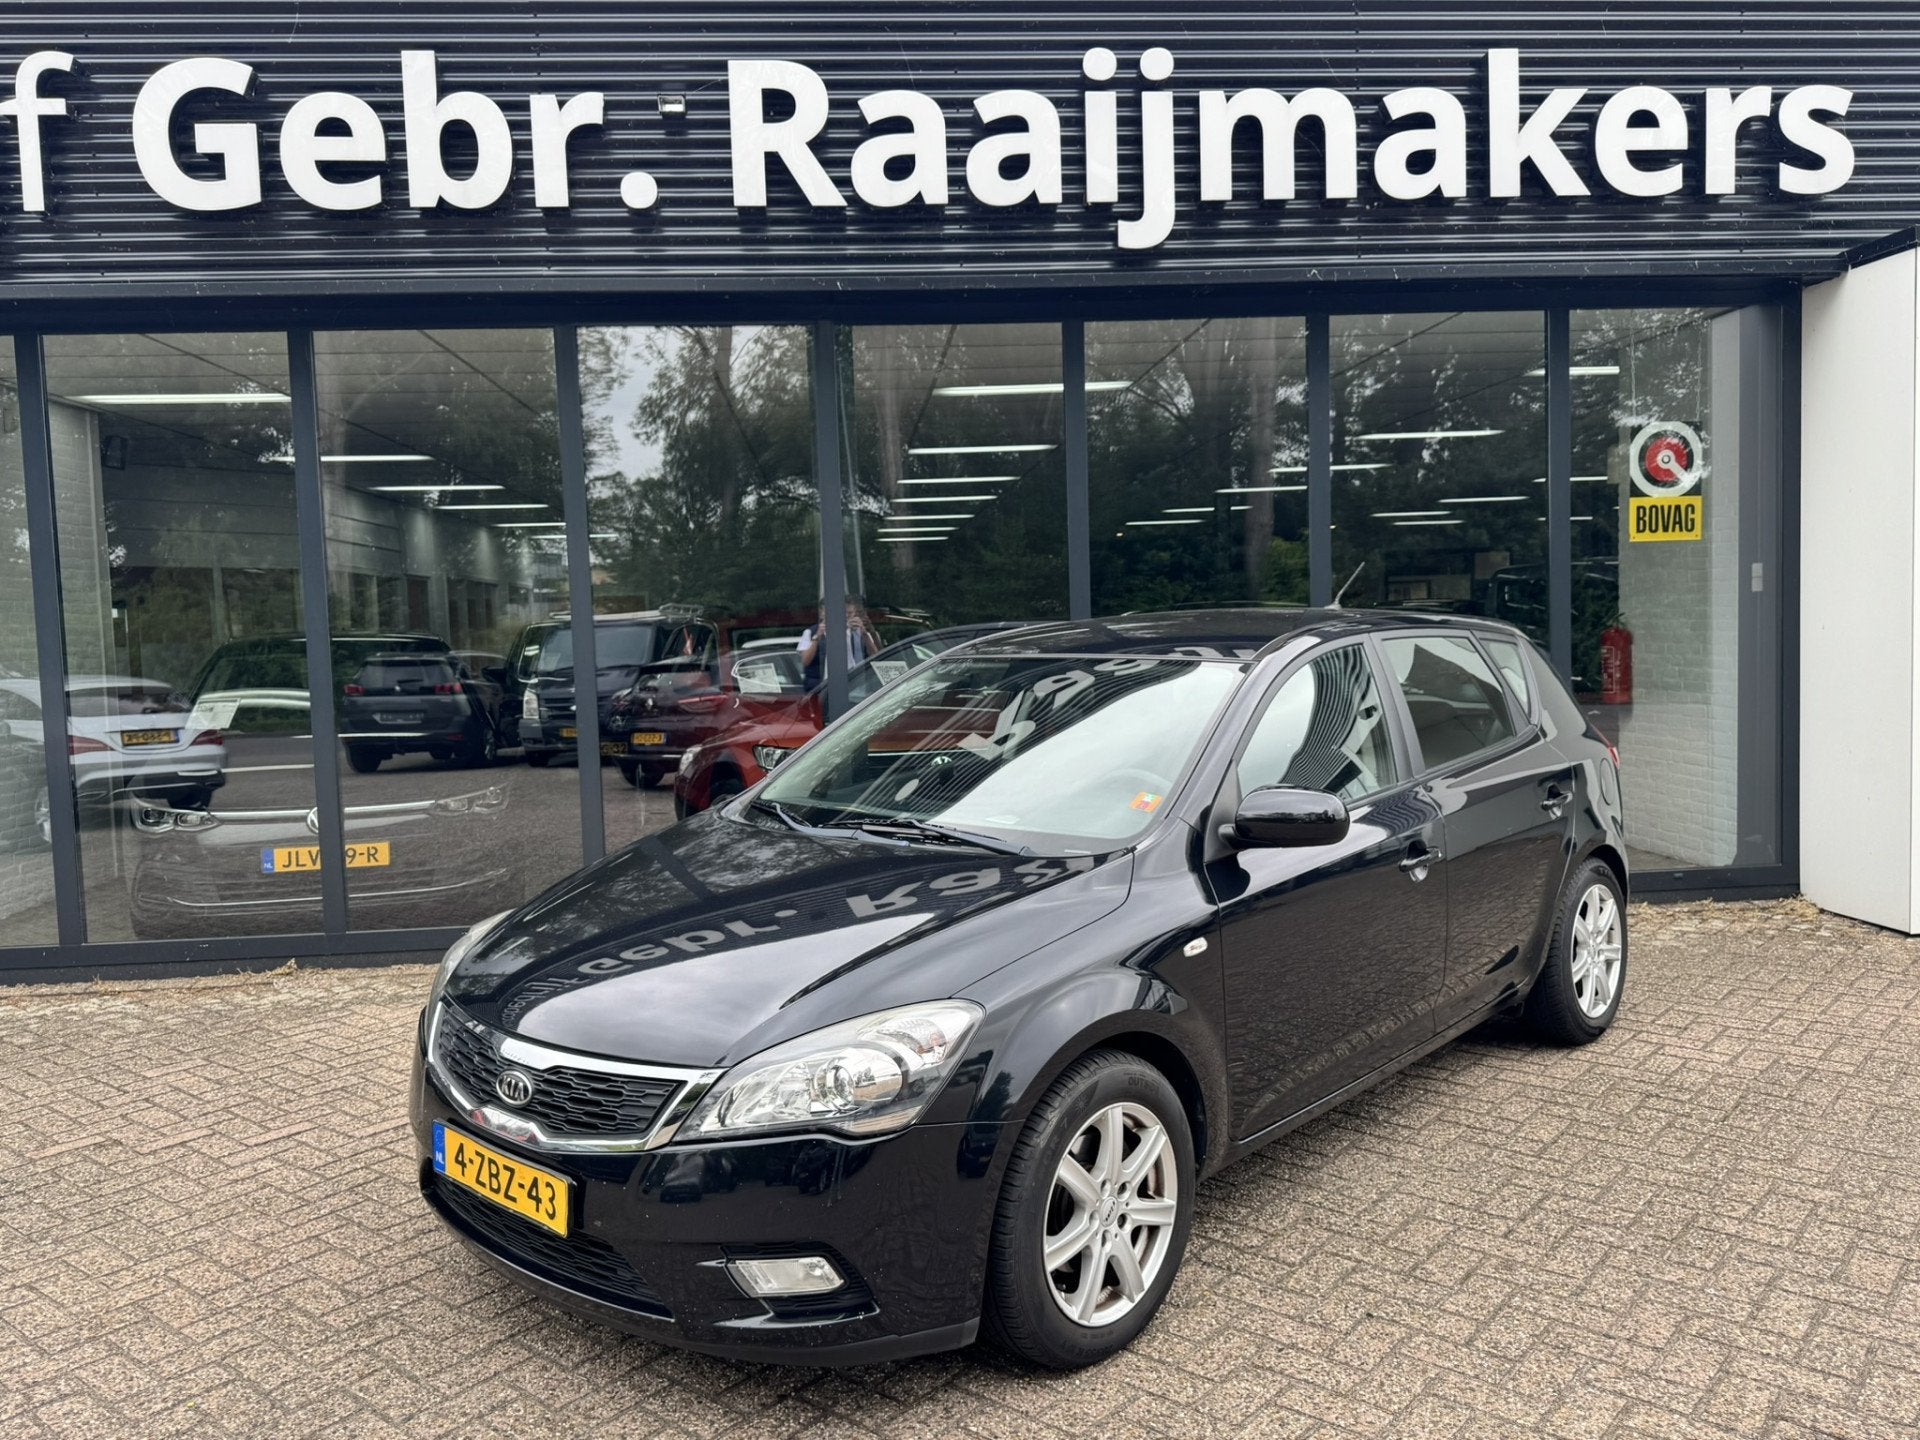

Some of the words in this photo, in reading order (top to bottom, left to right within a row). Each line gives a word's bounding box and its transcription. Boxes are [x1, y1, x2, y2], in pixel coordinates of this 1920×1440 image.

[132, 49, 659, 211] Gebr.
[727, 47, 1855, 249] Raaijmakers
[1636, 503, 1695, 533] BOVAG
[501, 1075, 525, 1099] KIA
[435, 1150, 445, 1165] NL
[454, 1142, 556, 1220] 4-ZBZ-43
